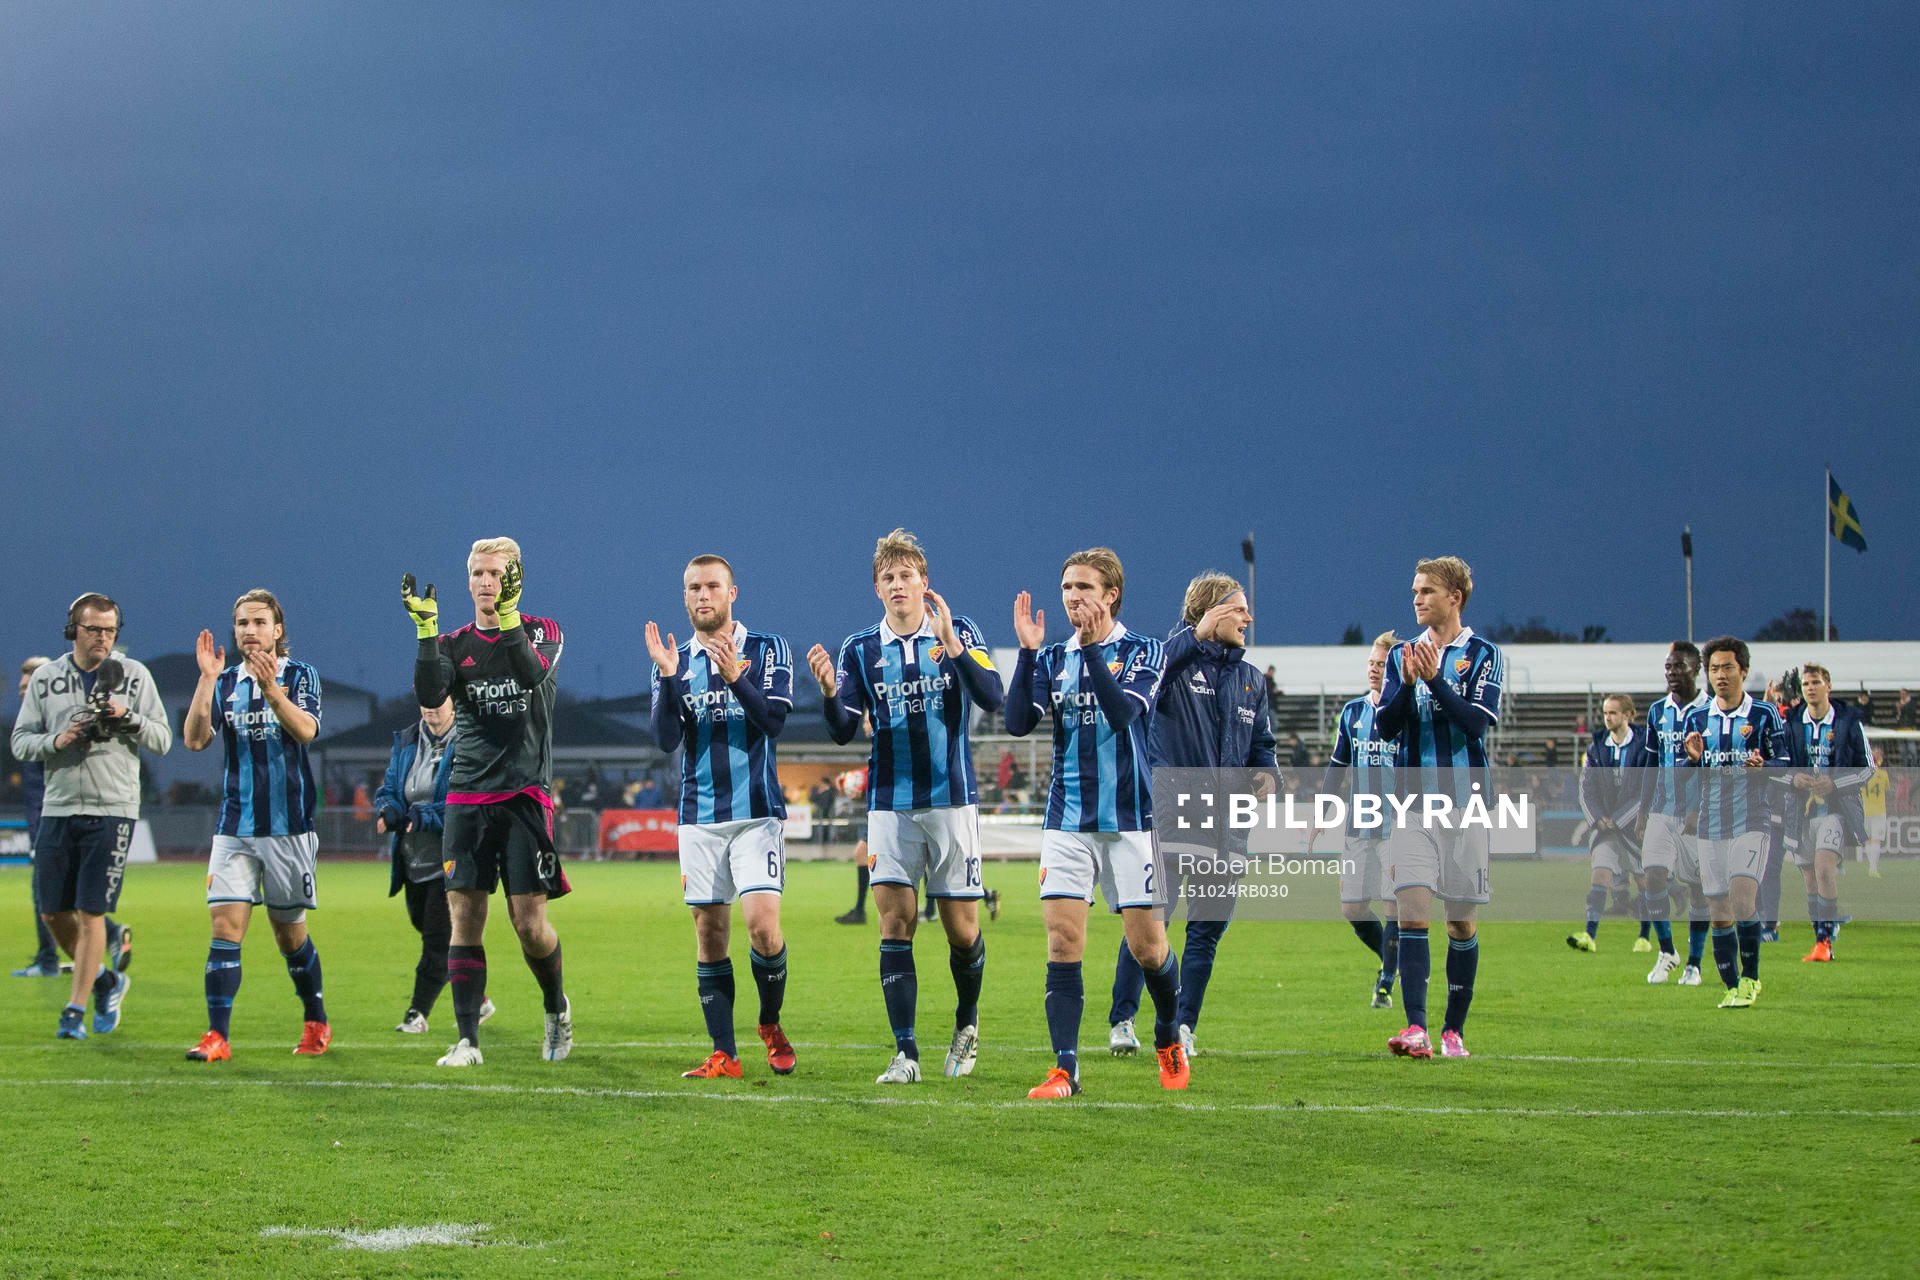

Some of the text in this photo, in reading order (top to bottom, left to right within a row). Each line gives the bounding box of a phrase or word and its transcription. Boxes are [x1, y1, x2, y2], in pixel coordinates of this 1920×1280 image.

[874, 672, 951, 700] Prioritet
[477, 698, 527, 716] Finans
[887, 695, 944, 717] Finans
[1357, 751, 1394, 767] Finans
[1823, 828, 1841, 847] 22
[536, 850, 557, 879] 23
[767, 851, 778, 878] 6
[965, 857, 981, 887] 13
[1748, 850, 1757, 868] 7
[303, 872, 313, 899] 8
[1144, 863, 1157, 894] 2
